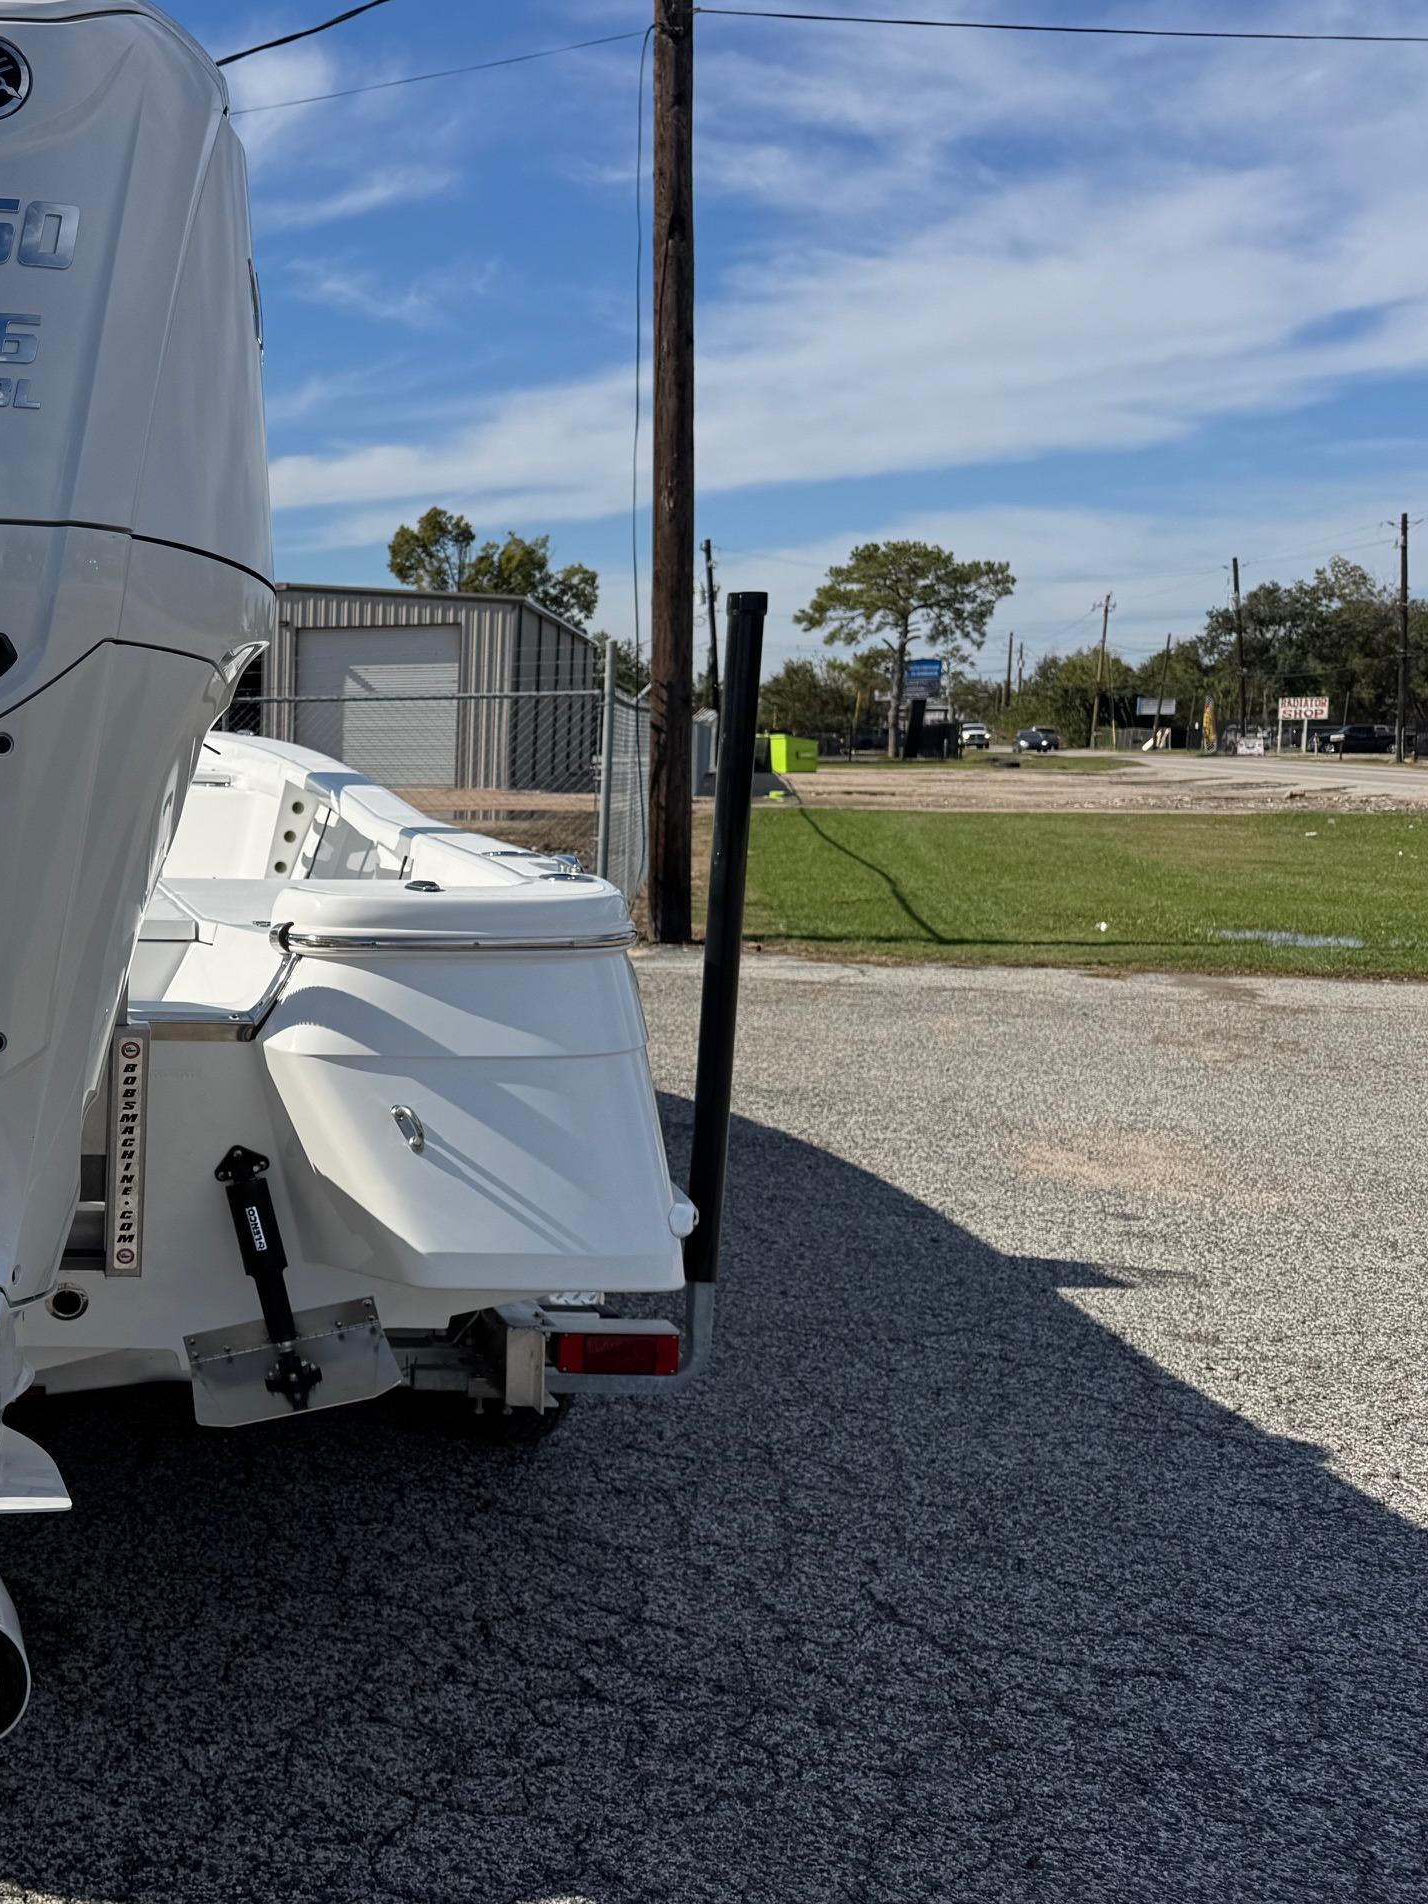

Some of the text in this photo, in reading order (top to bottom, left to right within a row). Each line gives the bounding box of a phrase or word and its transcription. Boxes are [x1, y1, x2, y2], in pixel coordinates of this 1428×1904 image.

[1281, 697, 1327, 708] RADIATOR
[1282, 708, 1324, 719] SHOP
[247, 1208, 263, 1242] LENCO
